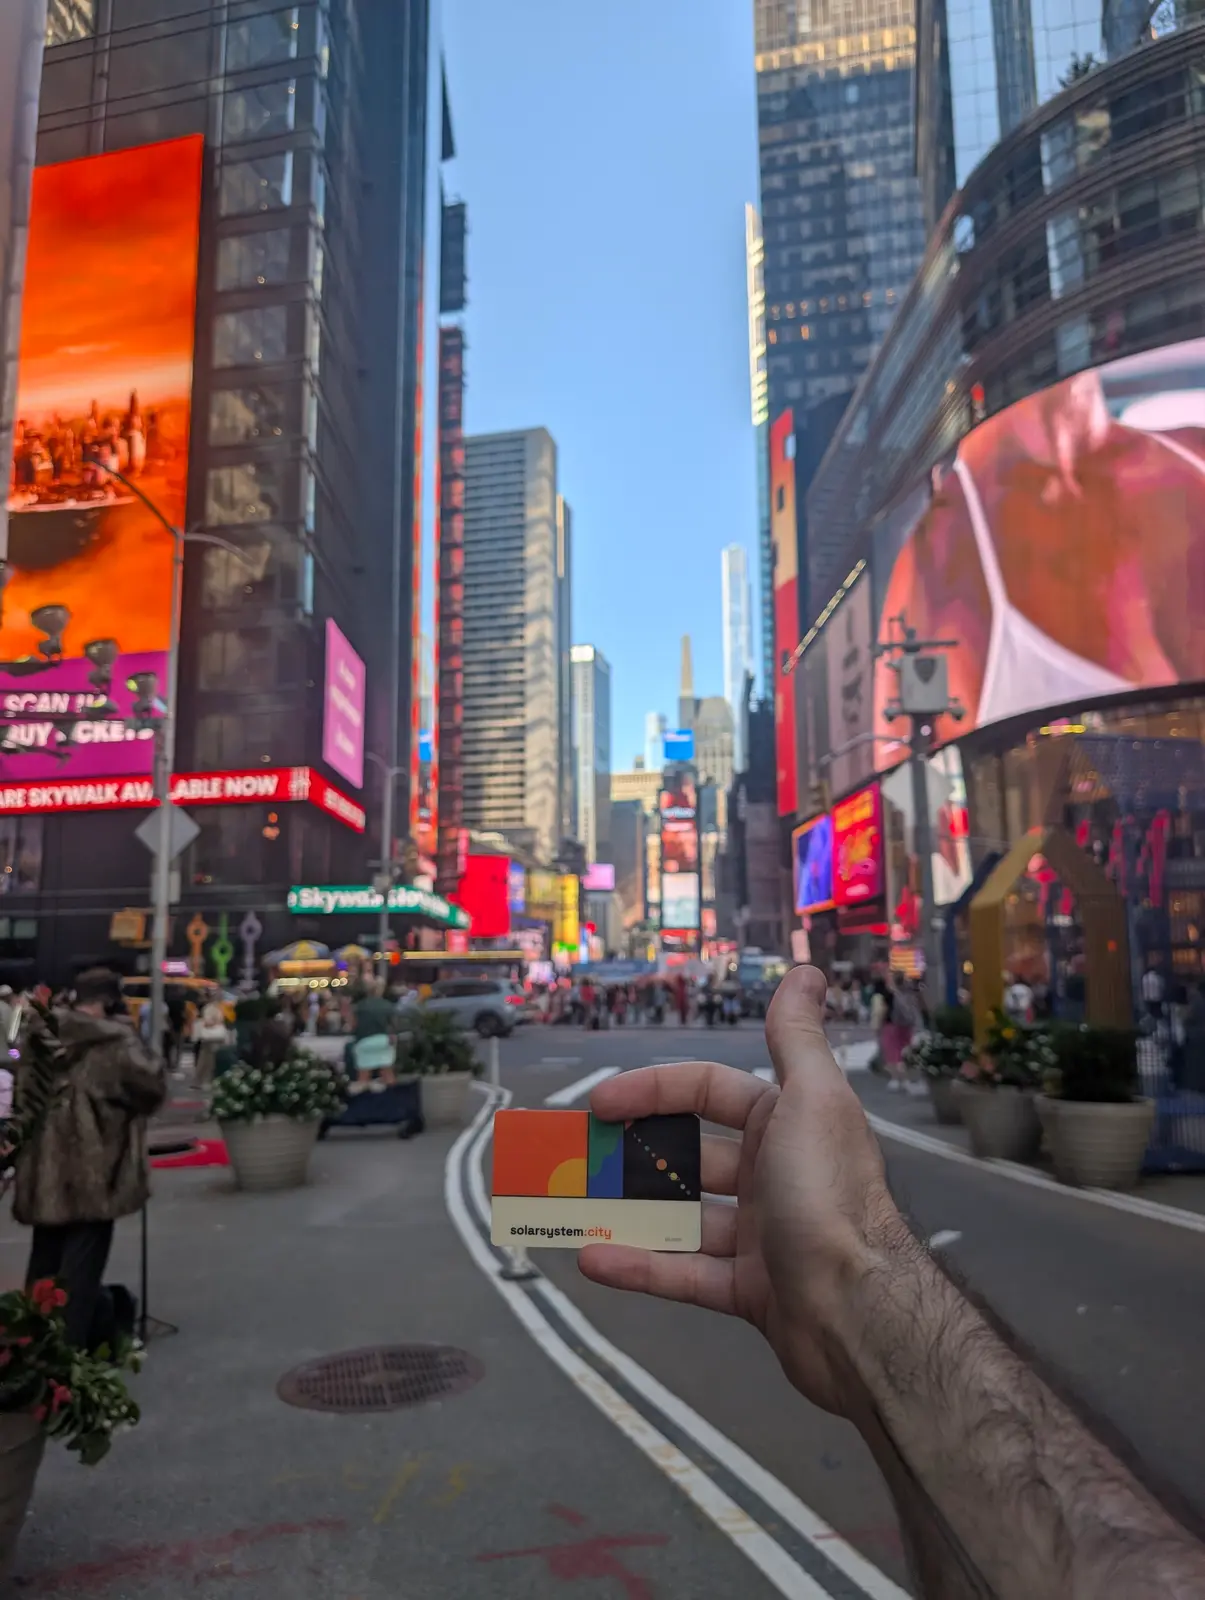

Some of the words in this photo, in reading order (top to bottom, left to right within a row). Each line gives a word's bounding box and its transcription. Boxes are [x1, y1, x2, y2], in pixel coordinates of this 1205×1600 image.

[4, 692, 70, 717] SCAN
[28, 782, 119, 807] SKYWALK
[225, 775, 279, 797] NOW
[510, 1225, 612, 1240] solarsystem:city
